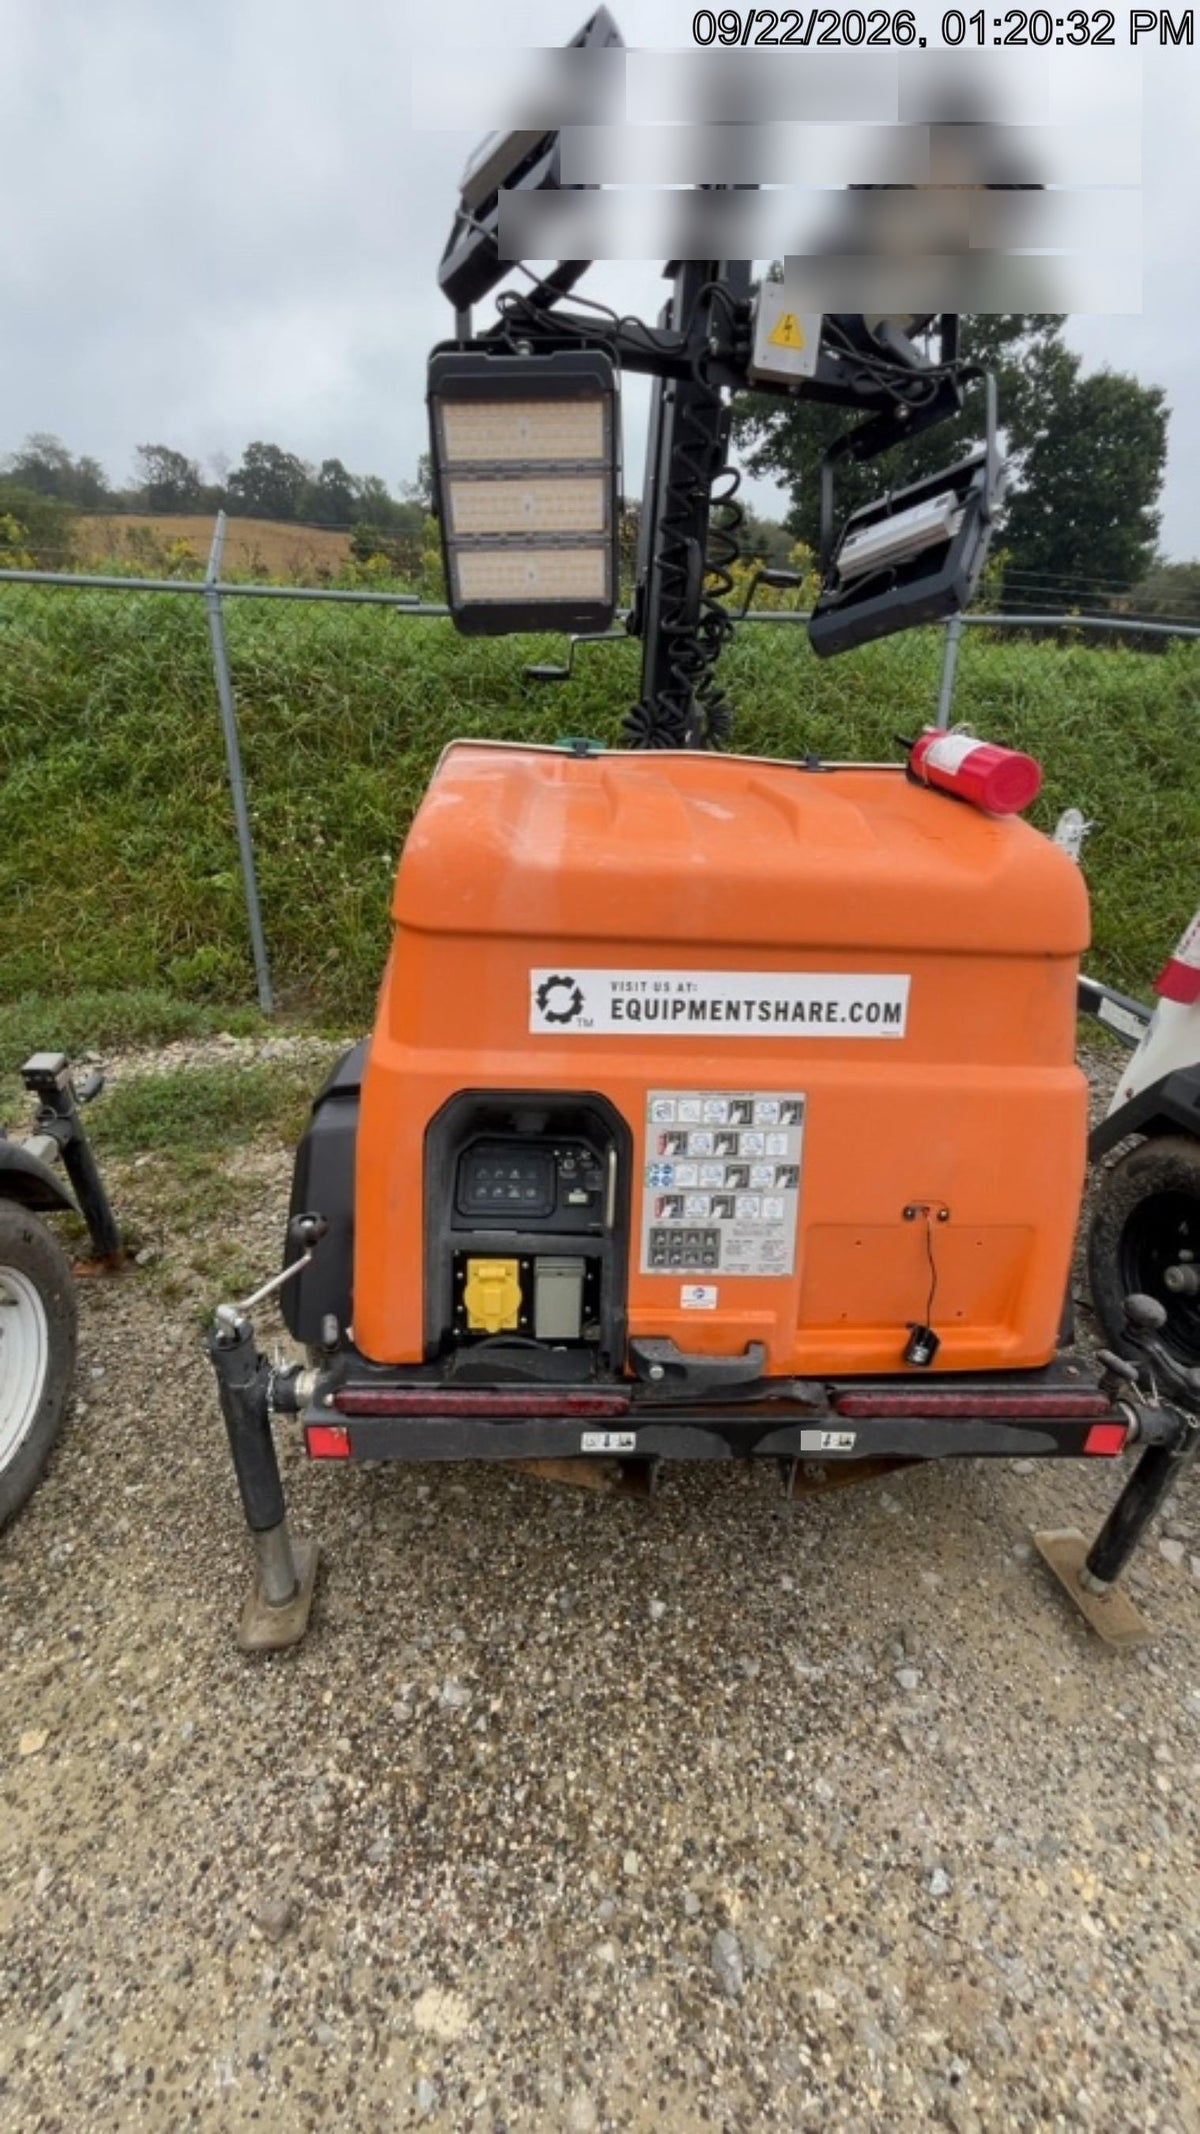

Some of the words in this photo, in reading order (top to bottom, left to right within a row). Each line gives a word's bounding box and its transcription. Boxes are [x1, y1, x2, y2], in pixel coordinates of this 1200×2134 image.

[611, 981, 647, 992] VISIT
[654, 981, 670, 992] US
[677, 982, 698, 993] AT:
[611, 998, 902, 1024] EQUIPMENTSHARE.COM
